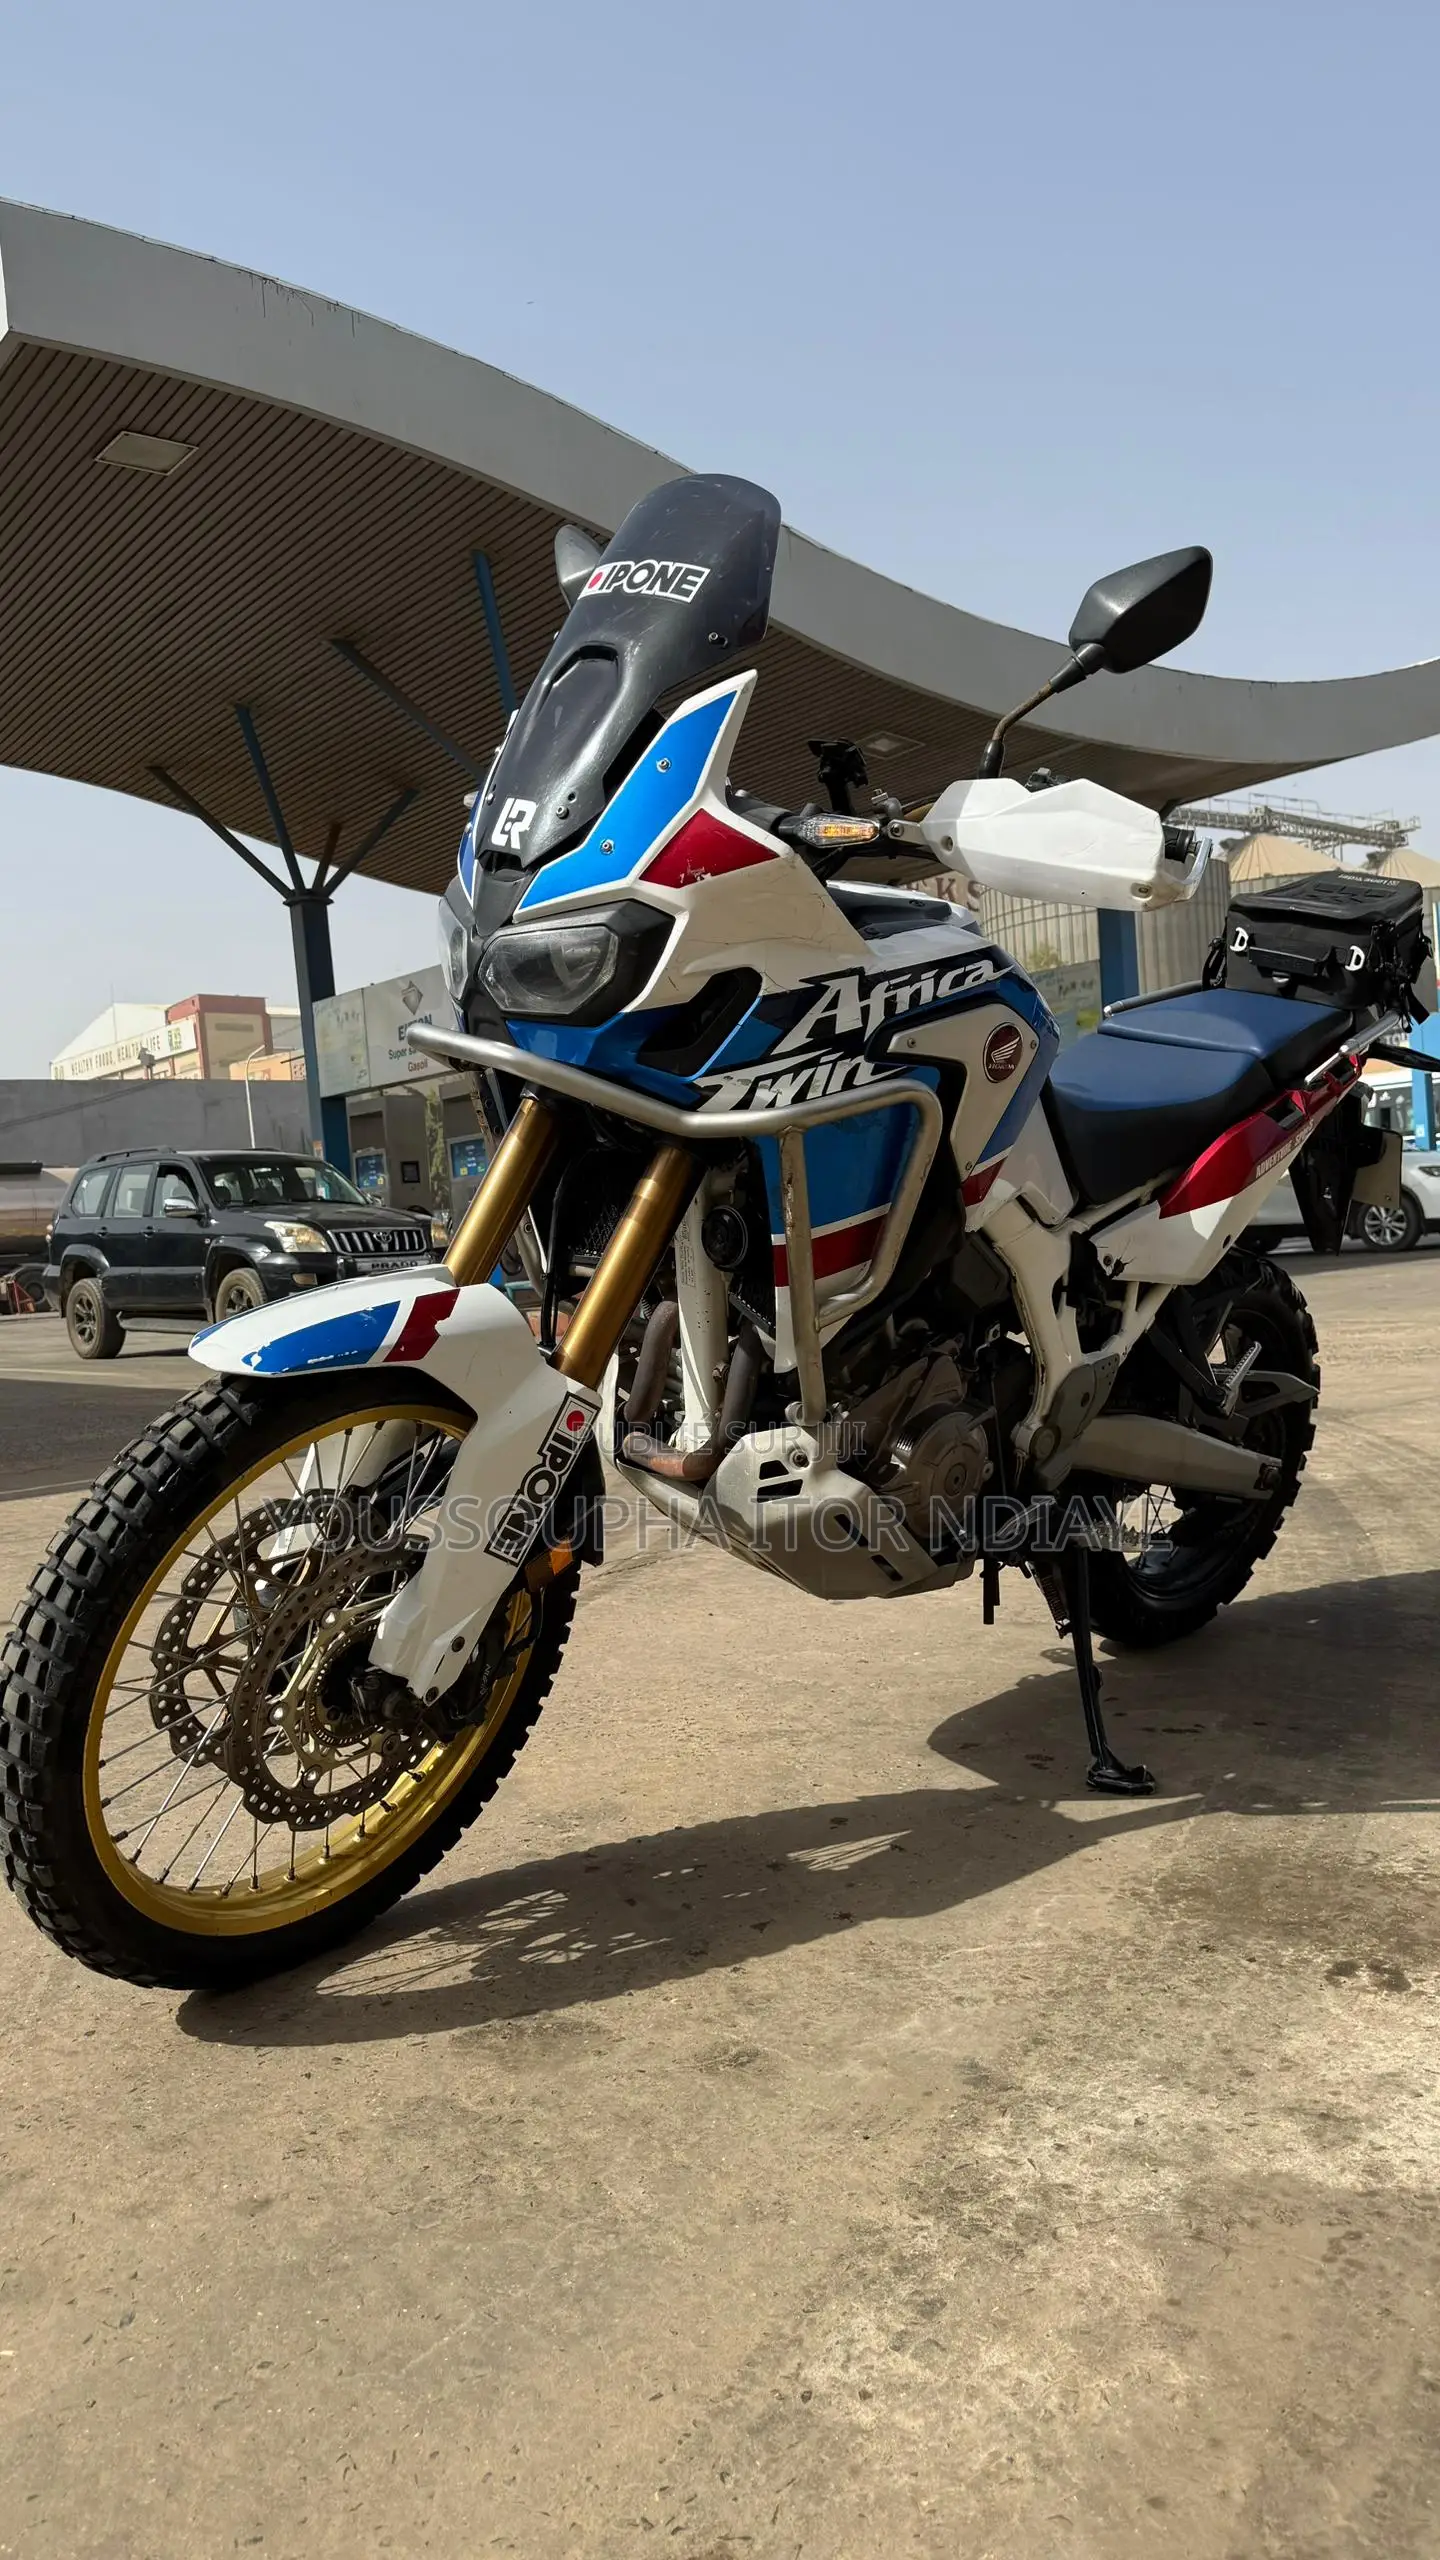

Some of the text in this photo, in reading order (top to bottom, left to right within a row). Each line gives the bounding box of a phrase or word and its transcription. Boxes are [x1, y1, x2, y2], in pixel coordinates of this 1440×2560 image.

[598, 562, 706, 599] IPONE
[771, 959, 1015, 1056] Africa
[388, 1048, 407, 1061] Super
[408, 1060, 428, 1072] Gasoil
[696, 1047, 915, 1112] Twin
[371, 1261, 418, 1269] PRADO
[493, 1431, 579, 1560] IPONE
